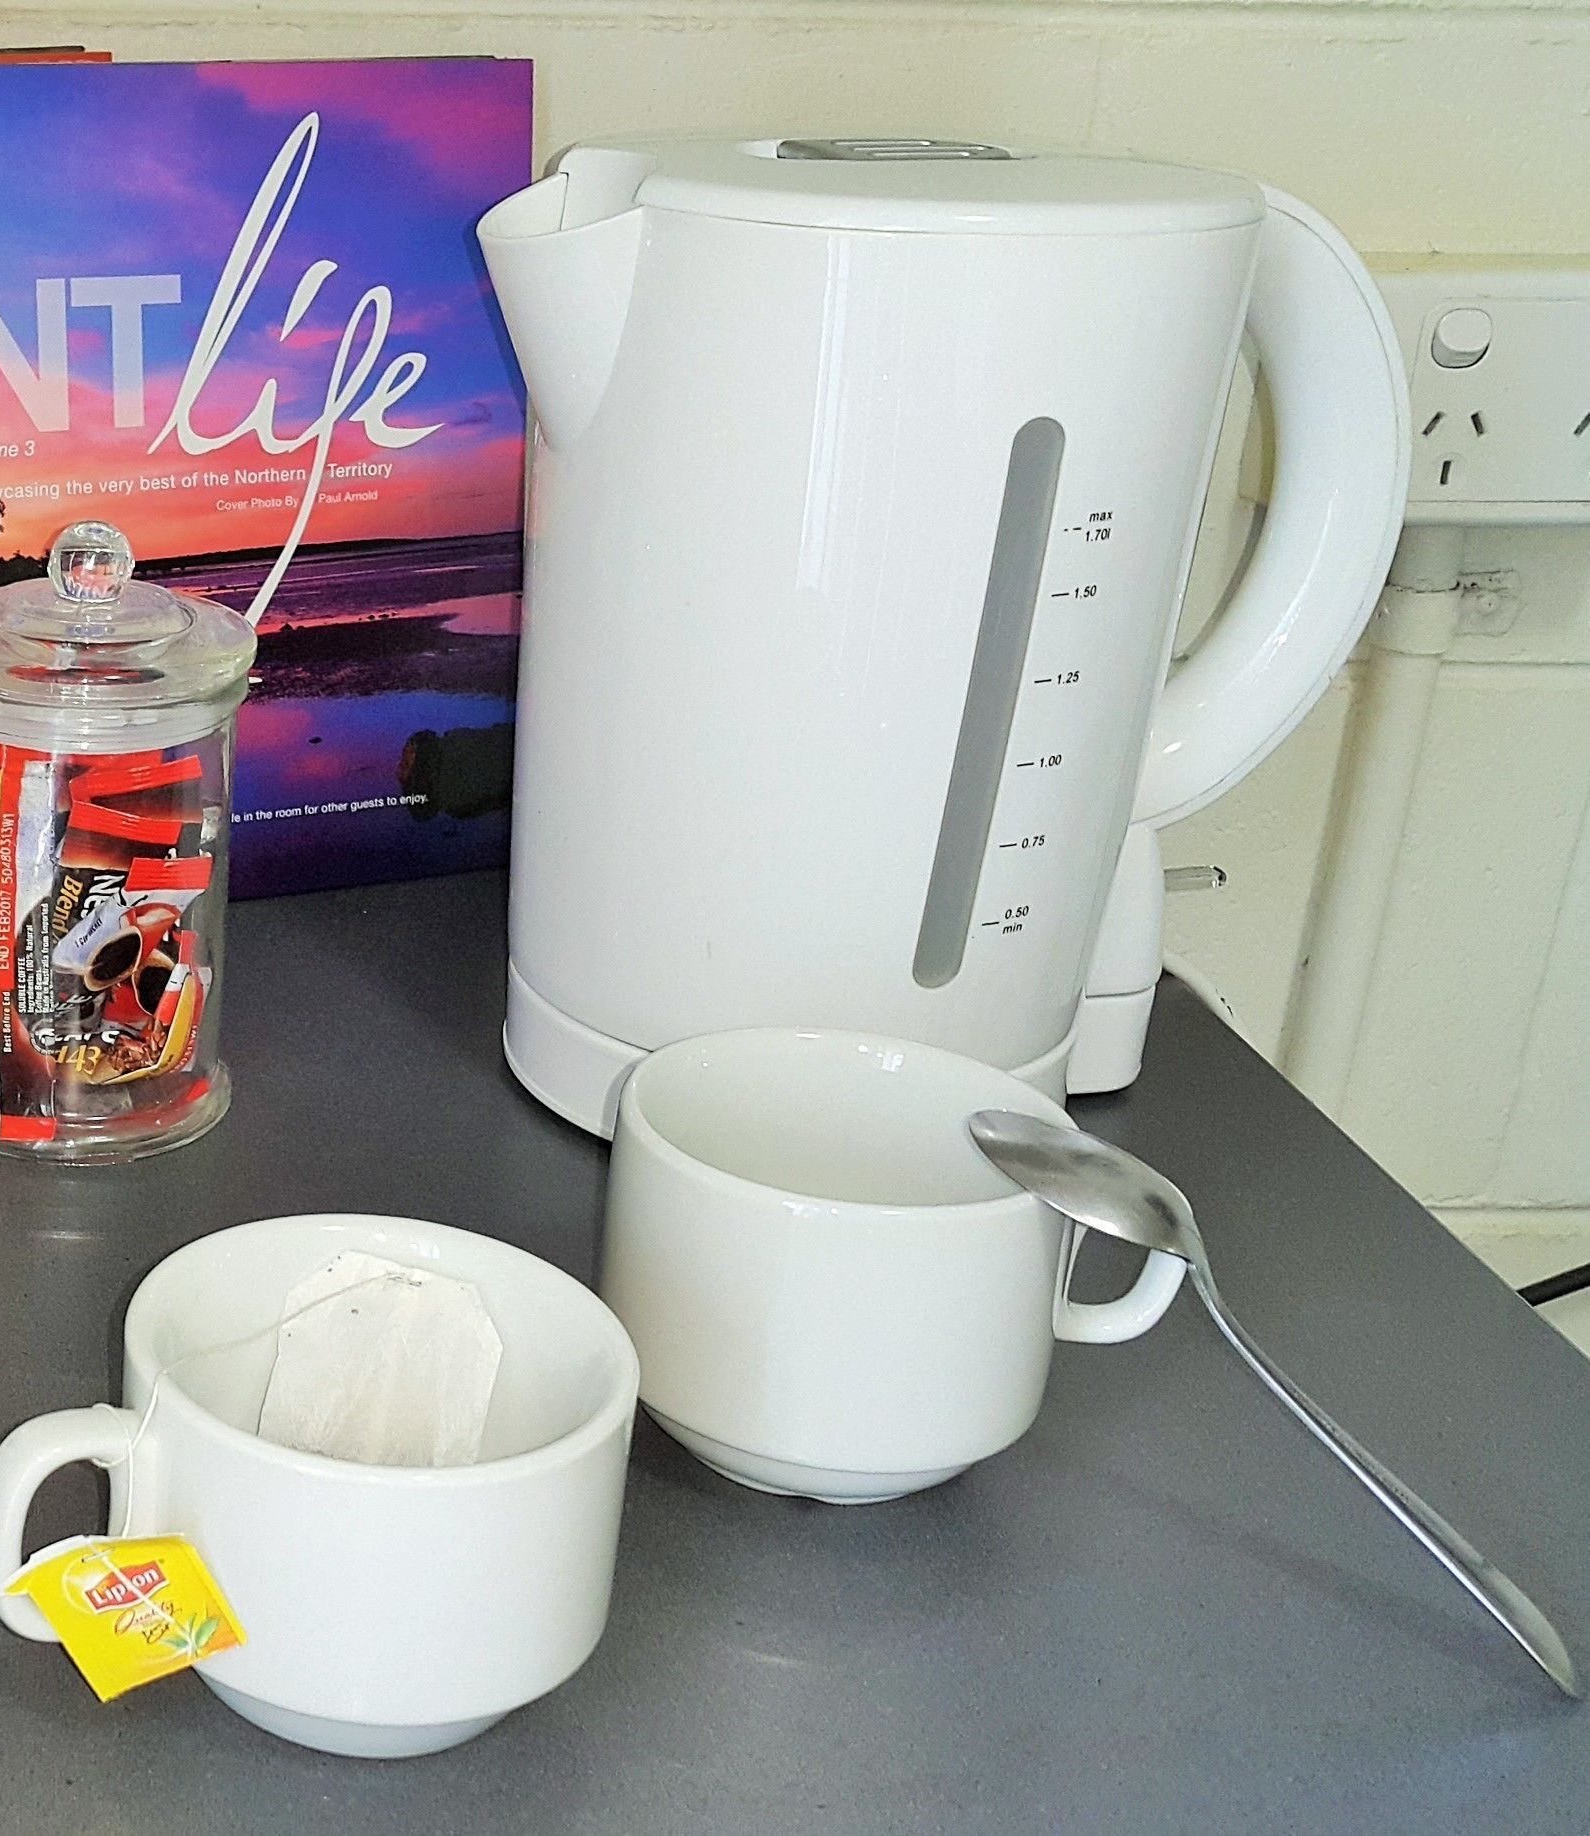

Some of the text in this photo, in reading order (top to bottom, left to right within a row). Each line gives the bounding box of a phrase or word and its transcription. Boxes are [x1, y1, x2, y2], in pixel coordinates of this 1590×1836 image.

[147, 111, 444, 627] life
[24, 440, 35, 457] 3
[66, 479, 93, 495] the
[99, 478, 134, 495] very
[139, 475, 176, 490] best
[182, 472, 197, 488] of
[203, 471, 229, 487] the
[235, 467, 306, 484] Northern
[327, 462, 393, 480] Territory
[216, 490, 378, 511] Cover Photo By Paul Arnold
[1089, 510, 1113, 523] max
[1074, 584, 1097, 599] 1.50
[1057, 671, 1080, 685] 1.25
[1039, 754, 1062, 768] 1.00
[243, 811, 253, 821] in
[255, 810, 273, 820] the
[275, 808, 302, 818] room
[304, 805, 318, 815] for
[321, 802, 348, 813] other
[350, 798, 384, 811] guests
[386, 796, 397, 806] to
[399, 793, 428, 805] enjoy.
[1021, 835, 1045, 849] 0.75
[51, 874, 83, 935] Blend
[1004, 905, 1030, 920] 0.50
[25, 924, 34, 951] Natural
[1002, 923, 1023, 935] min
[41, 936, 50, 954] from
[26, 951, 34, 972] 100%
[41, 955, 50, 986] Australia
[17, 956, 26, 1013] SOLUBLE COFFEE
[34, 991, 43, 1014] Coffee
[2, 991, 12, 1053] Best Before End
[91, 1568, 160, 1605] Lipon
